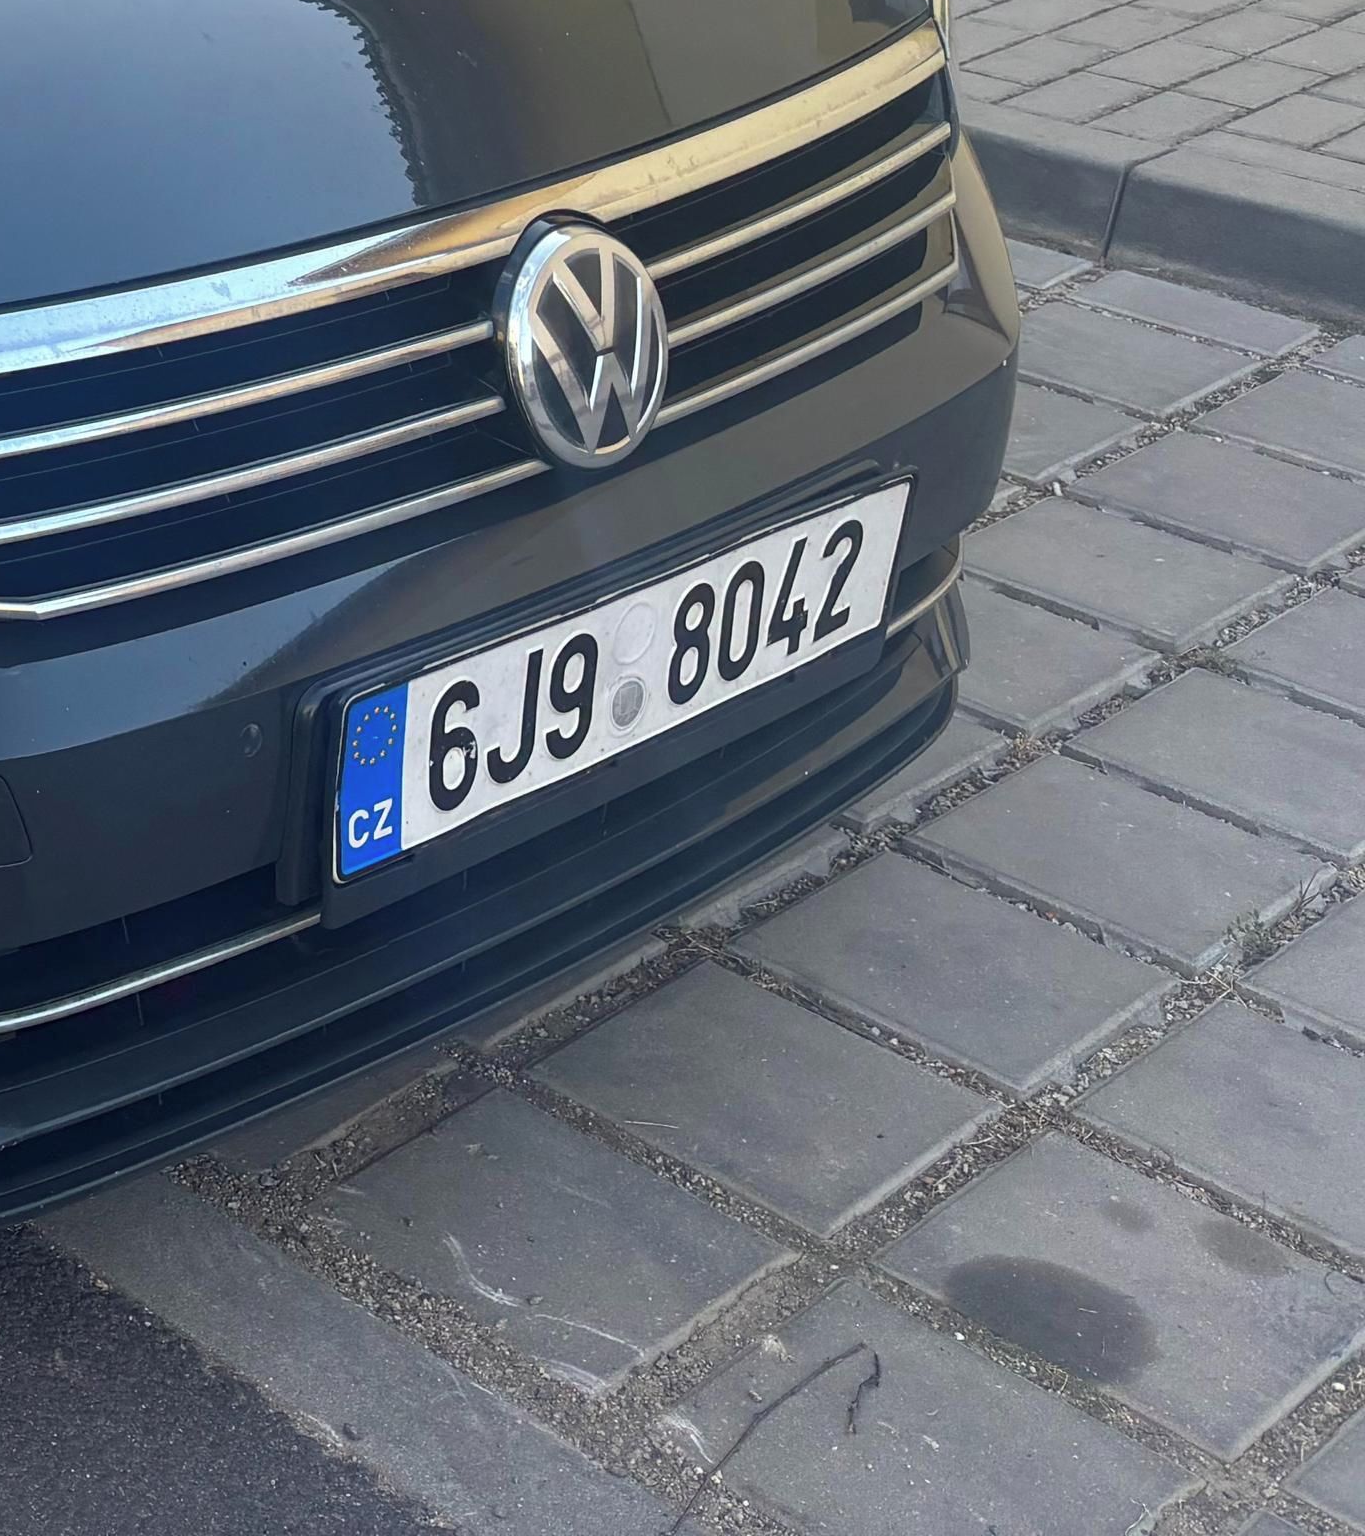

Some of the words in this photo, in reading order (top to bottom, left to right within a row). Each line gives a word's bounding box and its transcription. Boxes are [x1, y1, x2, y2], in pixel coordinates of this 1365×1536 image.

[515, 230, 665, 465] VW
[428, 633, 599, 812] 6J9
[668, 519, 863, 705] 8042
[348, 797, 393, 849] CZ
